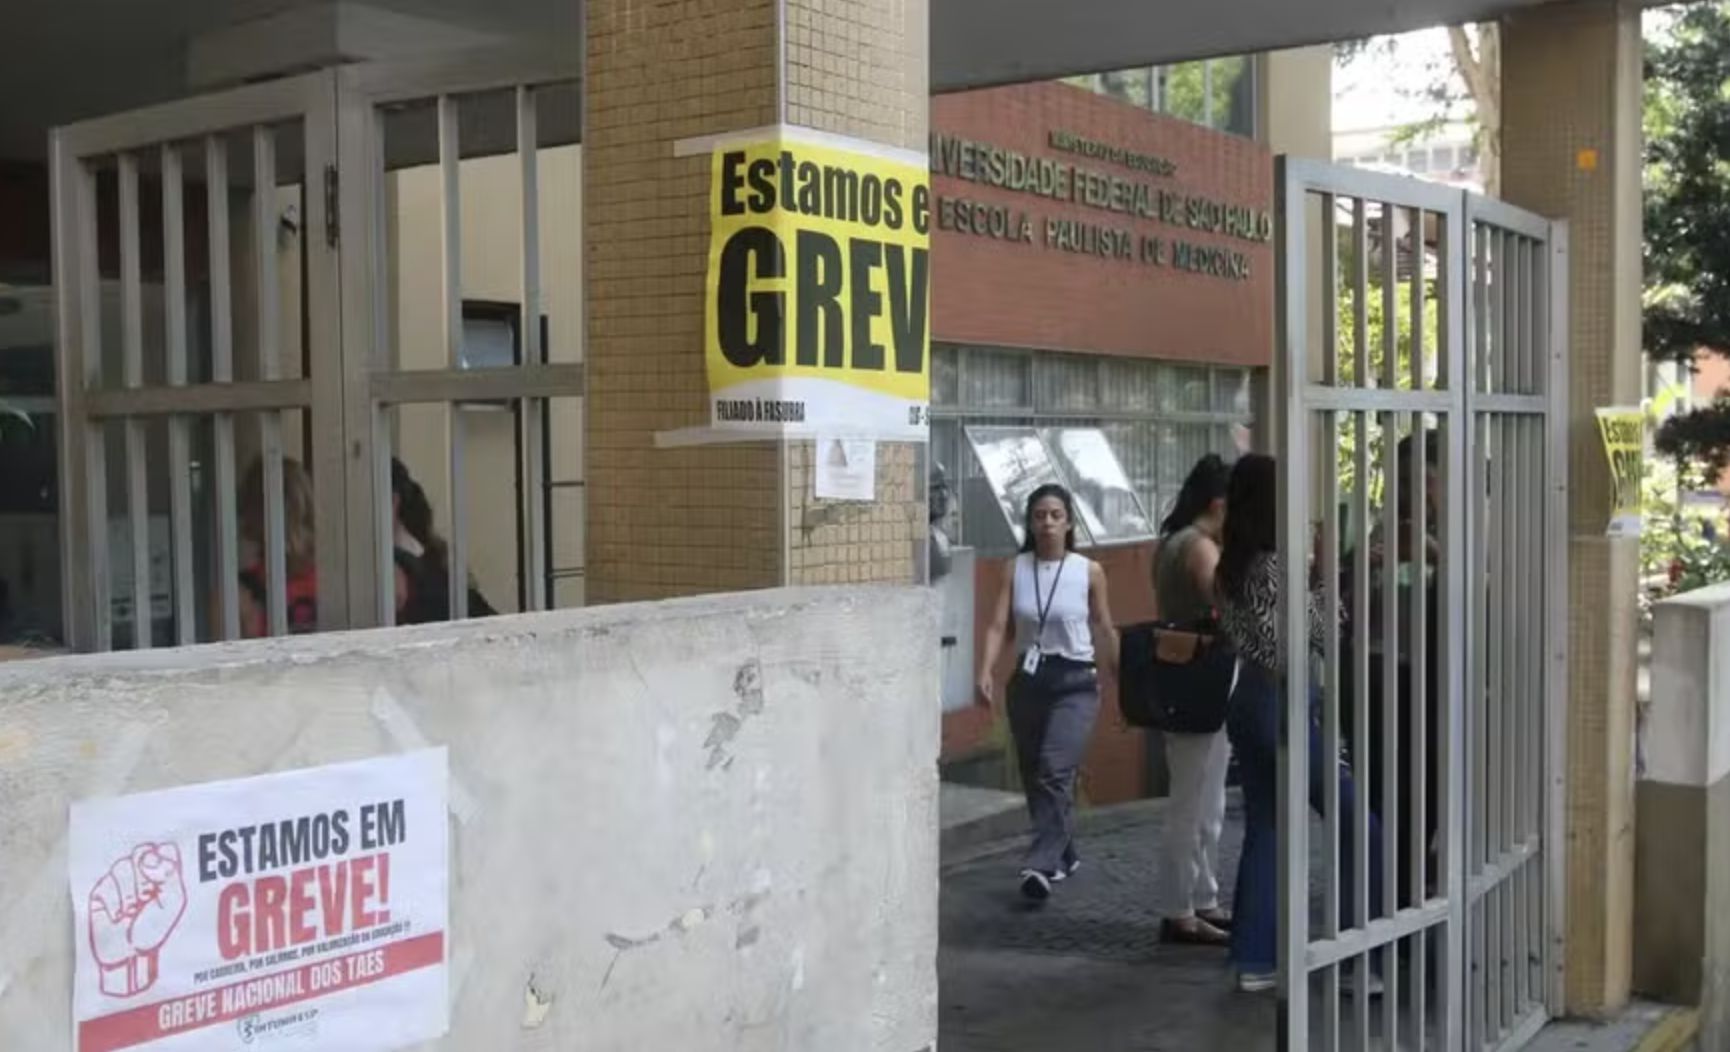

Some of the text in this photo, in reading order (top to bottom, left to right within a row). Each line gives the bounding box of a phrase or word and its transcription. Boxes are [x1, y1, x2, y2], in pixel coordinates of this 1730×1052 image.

[721, 150, 903, 229] Estamos
[1070, 166, 1158, 219] FEDERAL
[1159, 189, 1184, 228] DE
[1222, 203, 1273, 245] PAULO
[937, 196, 1250, 280] ESCOLA PAULISTA DE MEDICINA
[717, 400, 754, 422] FILIADO
[199, 799, 406, 883] ESTAMOS EM
[217, 852, 391, 960] GREVE!
[158, 949, 385, 1030] GREVE NACIONAL DOS TAES
